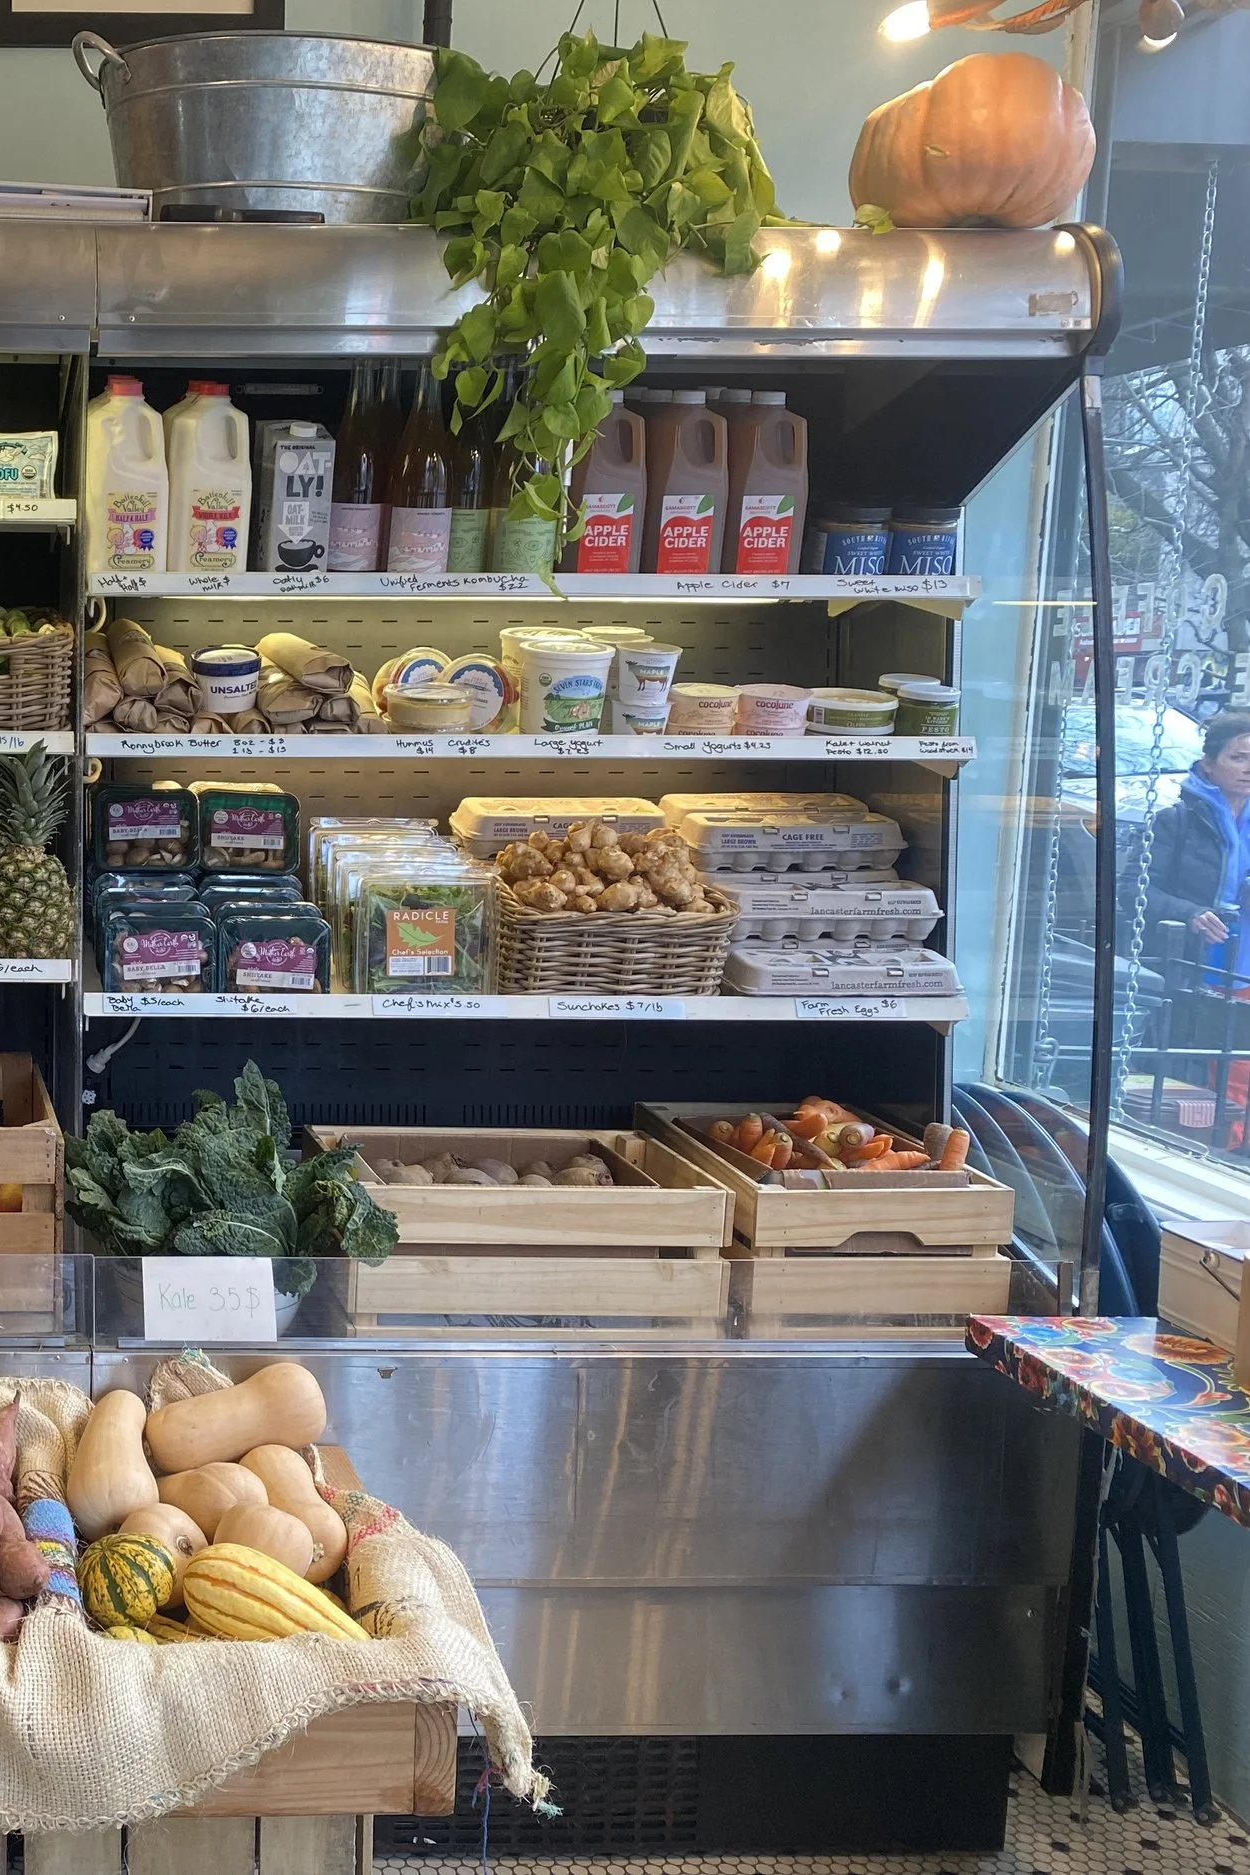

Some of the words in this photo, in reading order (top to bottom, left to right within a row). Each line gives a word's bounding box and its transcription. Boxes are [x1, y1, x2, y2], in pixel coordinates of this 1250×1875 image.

[286, 475, 324, 498] LY!
[122, 504, 145, 513] Valley
[207, 502, 229, 511] Valley
[584, 525, 629, 536] APPLE
[663, 526, 709, 537] APPLE
[742, 526, 789, 537] APPLE
[584, 536, 626, 547] CIDER
[664, 537, 706, 548] CIDER
[743, 537, 786, 548] CIDER
[842, 535, 865, 546] SOUTH
[908, 535, 931, 546] SOUTH
[113, 553, 151, 568] Creamery
[195, 551, 233, 568] Creamery
[834, 555, 885, 576] MISO
[899, 555, 953, 576] MISO
[189, 577, 219, 586] Whole
[273, 576, 303, 588] Oatly
[380, 574, 418, 588] Unified
[410, 579, 460, 591] Ferments
[499, 582, 528, 591] $22
[676, 580, 714, 592] Apple
[721, 580, 759, 588] Cider
[771, 580, 791, 590] $7
[836, 578, 876, 587] Sweet
[921, 578, 948, 593] $13
[553, 681, 573, 694] SEVEN
[698, 700, 733, 709] cocojune
[755, 700, 794, 709] cocojune
[579, 721, 593, 730] PLAIN
[121, 739, 183, 754] Ronnybrook
[188, 739, 221, 747] Butter
[396, 739, 434, 747] Hummus
[534, 739, 566, 749] Large
[664, 742, 695, 750] Small
[393, 911, 449, 921] RADICLE
[811, 906, 922, 916] lancasterfarmfresh.com
[832, 980, 943, 990] lancasterfarmfresh.com
[241, 1003, 291, 1013] $6/each
[382, 998, 423, 1012] Chef's
[557, 1002, 620, 1012] Sunchokes
[625, 1001, 663, 1013] $7/lb
[801, 1000, 830, 1010] Farm
[881, 999, 897, 1009] $6
[818, 1006, 850, 1016] Fresh
[855, 1005, 879, 1018] Eggs
[158, 1282, 199, 1312] Kale
